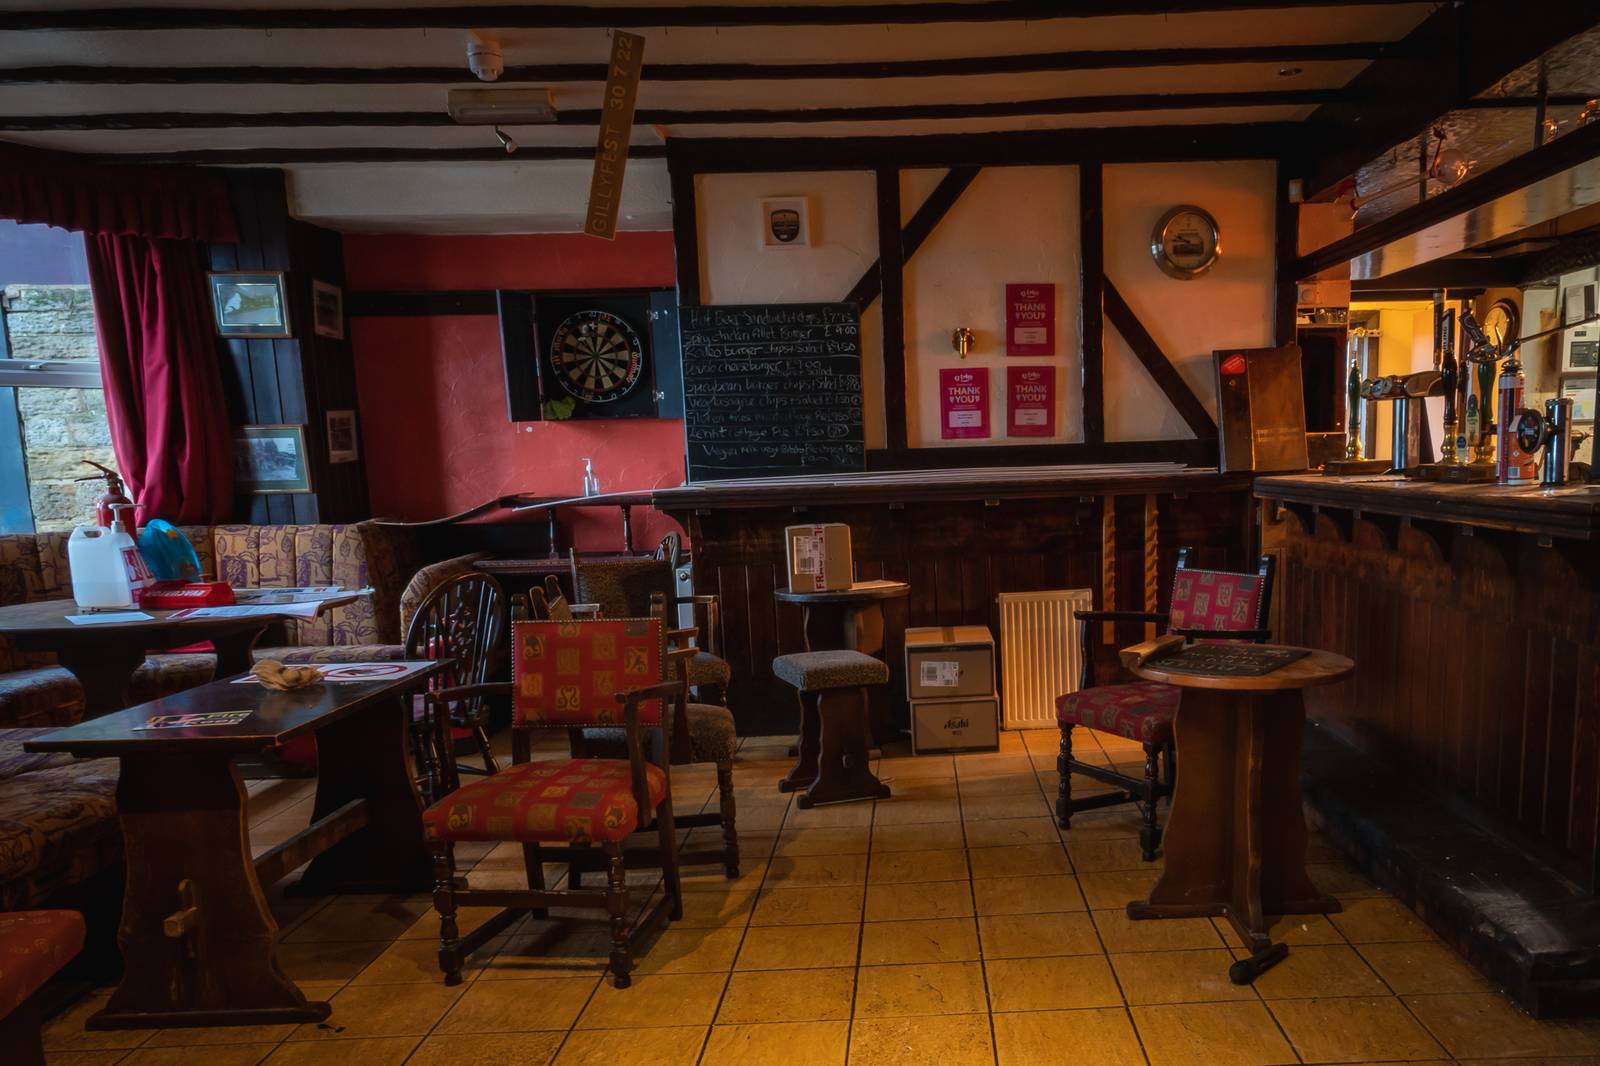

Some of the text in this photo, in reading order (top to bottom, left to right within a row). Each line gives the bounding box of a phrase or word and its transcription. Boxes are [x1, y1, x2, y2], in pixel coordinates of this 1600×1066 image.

[591, 36, 633, 234] GILLYFEST 30 7 22
[1014, 303, 1046, 311] THANK
[1021, 312, 1041, 320] YOU
[947, 387, 980, 395] THANK
[1015, 385, 1047, 393] THANK
[955, 395, 975, 404] YOU
[1022, 393, 1041, 402] YOU
[943, 717, 969, 729] Asahi
